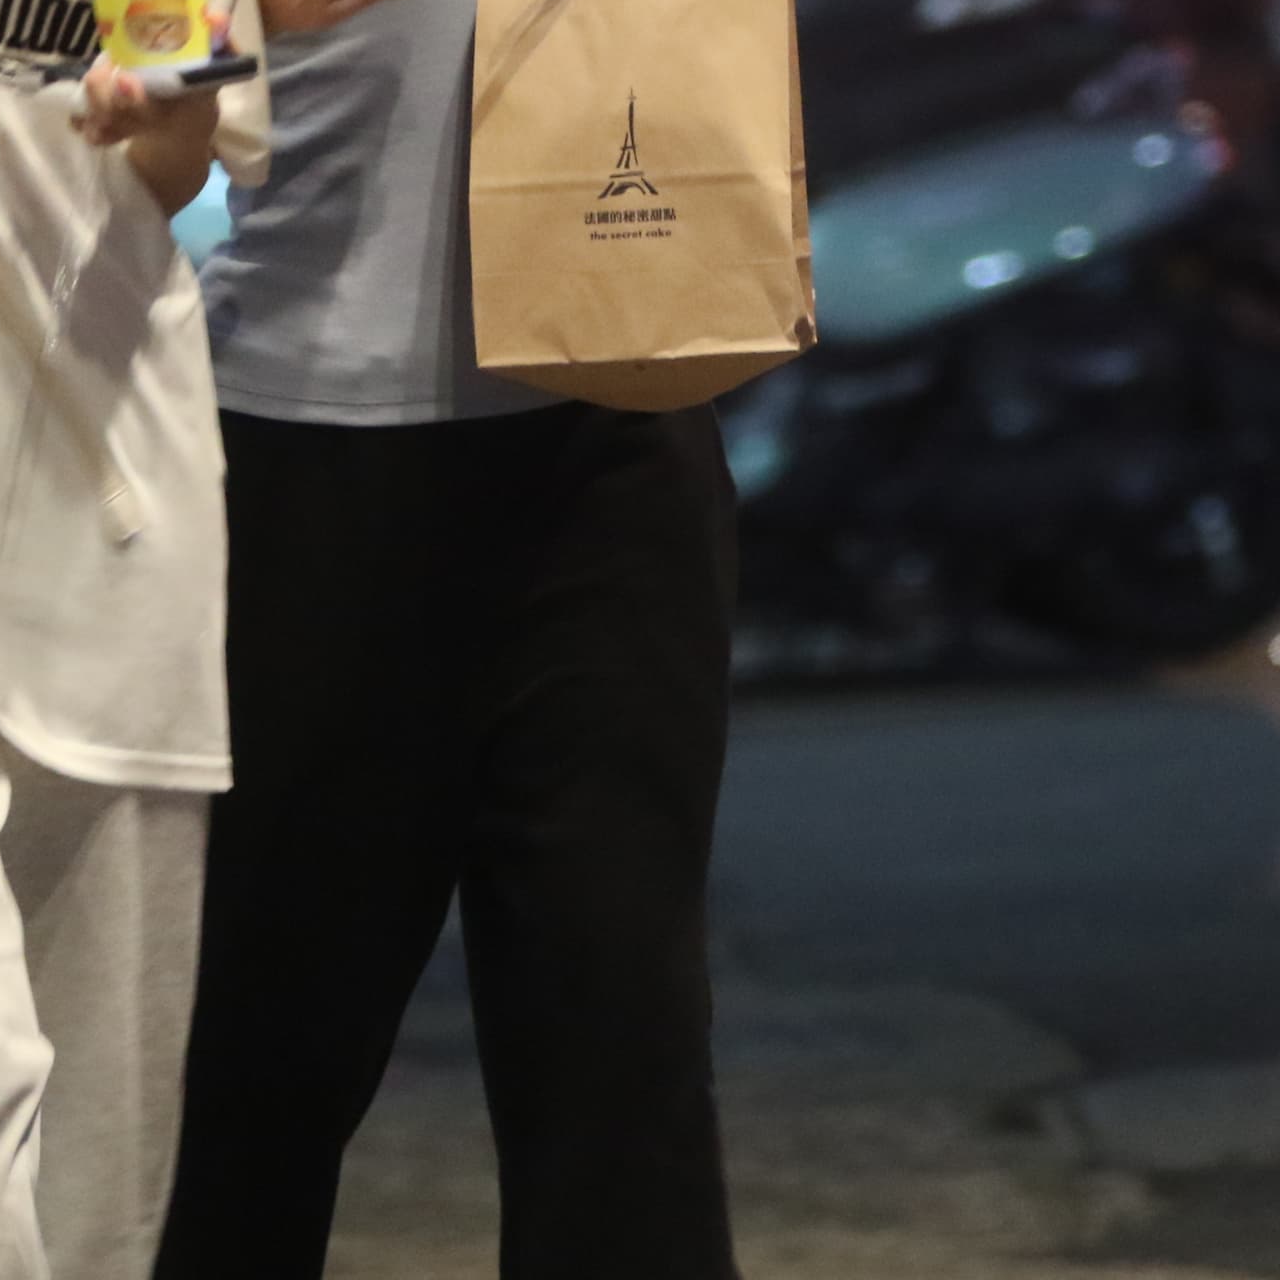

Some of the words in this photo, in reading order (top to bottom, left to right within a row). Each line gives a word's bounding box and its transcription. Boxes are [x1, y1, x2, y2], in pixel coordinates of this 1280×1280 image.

[590, 231, 608, 241] the
[610, 229, 642, 240] secret
[645, 227, 672, 238] cake
